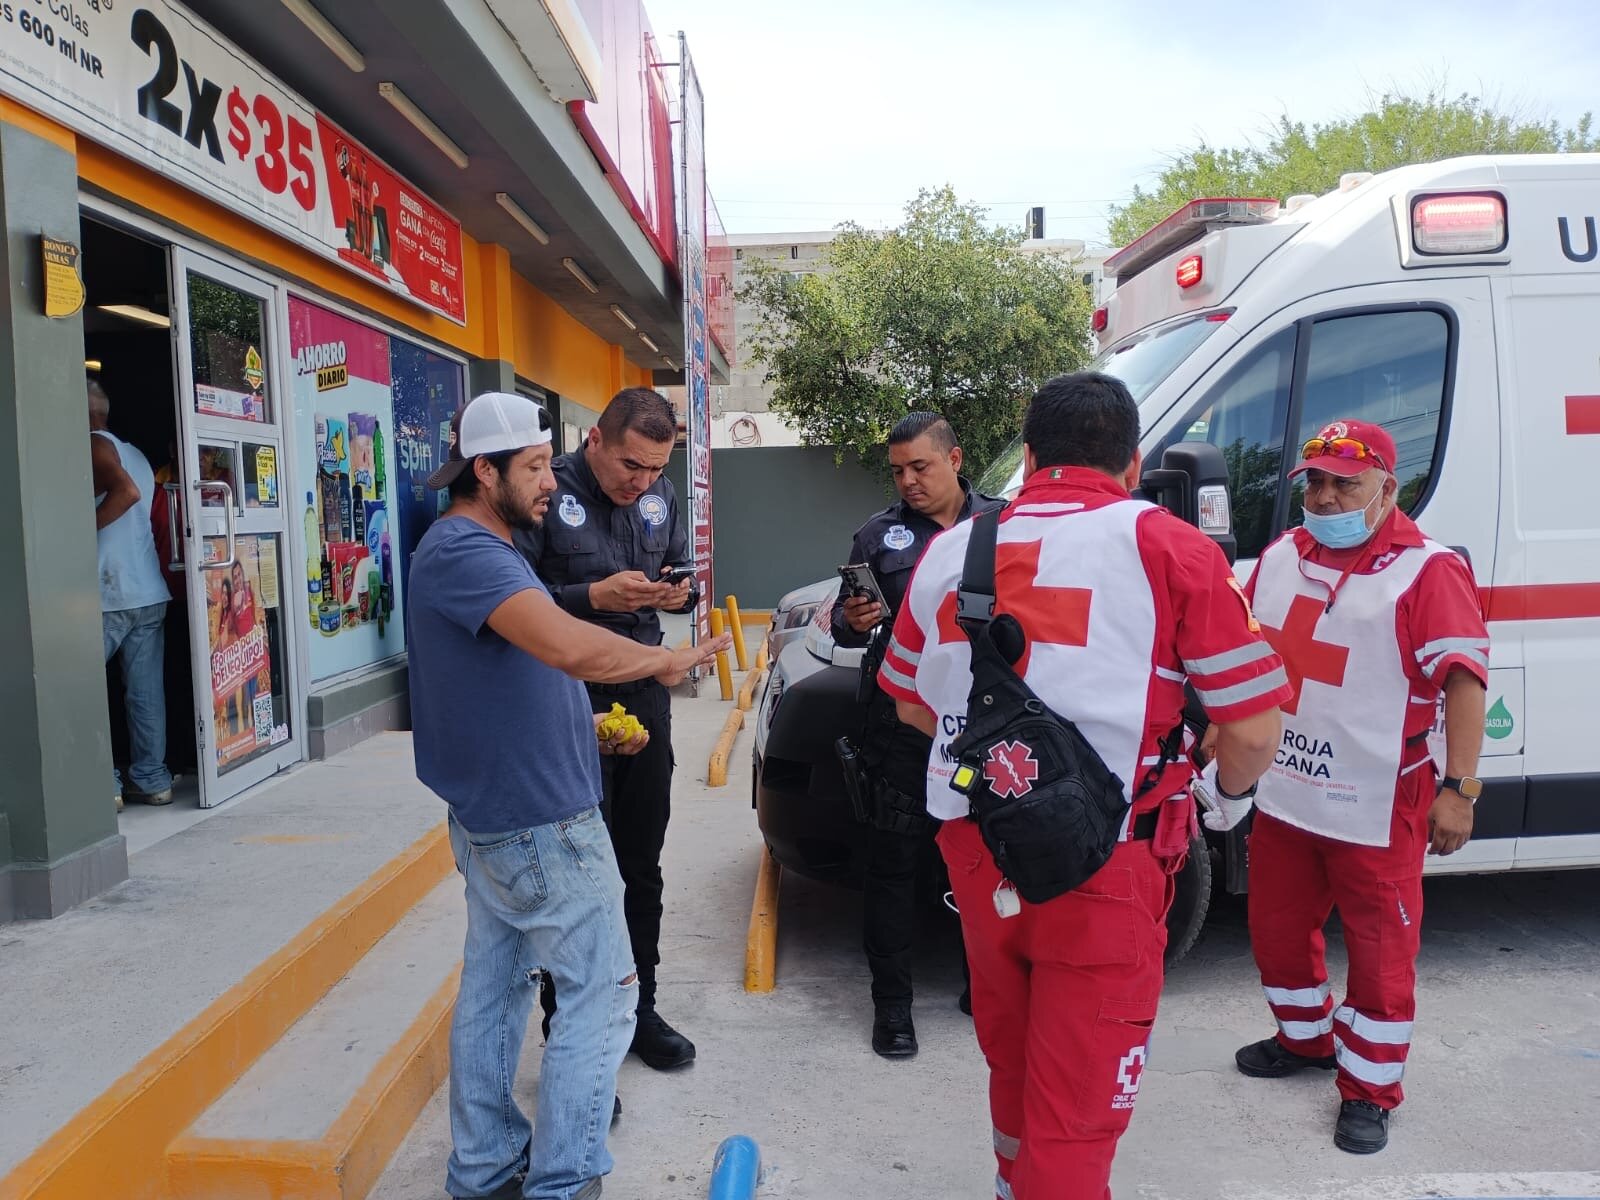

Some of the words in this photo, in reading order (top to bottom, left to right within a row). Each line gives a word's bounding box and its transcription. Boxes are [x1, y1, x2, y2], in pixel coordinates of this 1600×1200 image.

[48, 0, 89, 37] Colas
[0, 2, 14, 23] s
[19, 9, 55, 47] 600
[59, 36, 77, 63] ml
[80, 47, 104, 79] NR
[227, 85, 317, 212] $35
[400, 209, 423, 238] GANA
[298, 340, 347, 375] AHORRO
[318, 368, 346, 387] DIARIO
[401, 437, 433, 479] spin
[1283, 729, 1333, 758] ROJA
